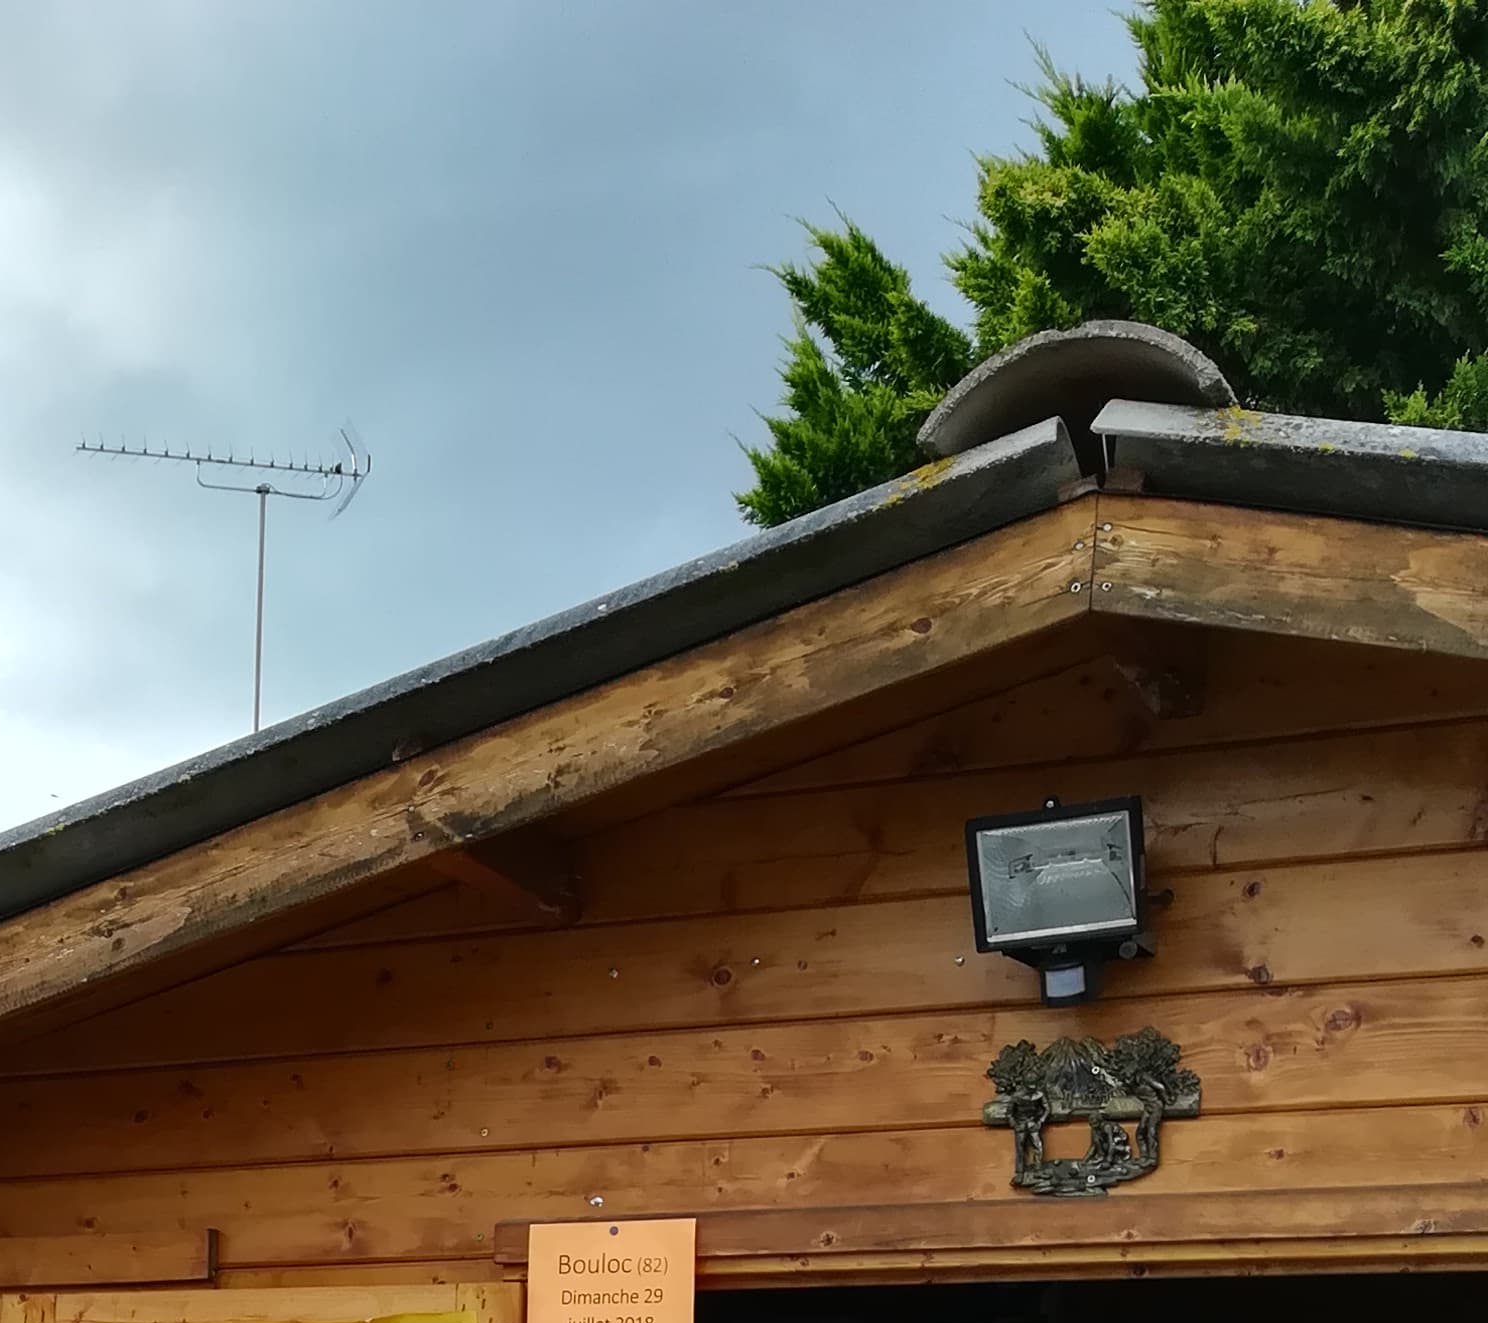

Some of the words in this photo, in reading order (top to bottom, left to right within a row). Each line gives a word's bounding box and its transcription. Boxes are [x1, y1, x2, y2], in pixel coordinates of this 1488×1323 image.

[558, 1253, 632, 1275] Bouloc
[637, 1256, 669, 1276] (82)
[561, 1288, 639, 1305] Dimanche
[644, 1288, 664, 1304] 29
